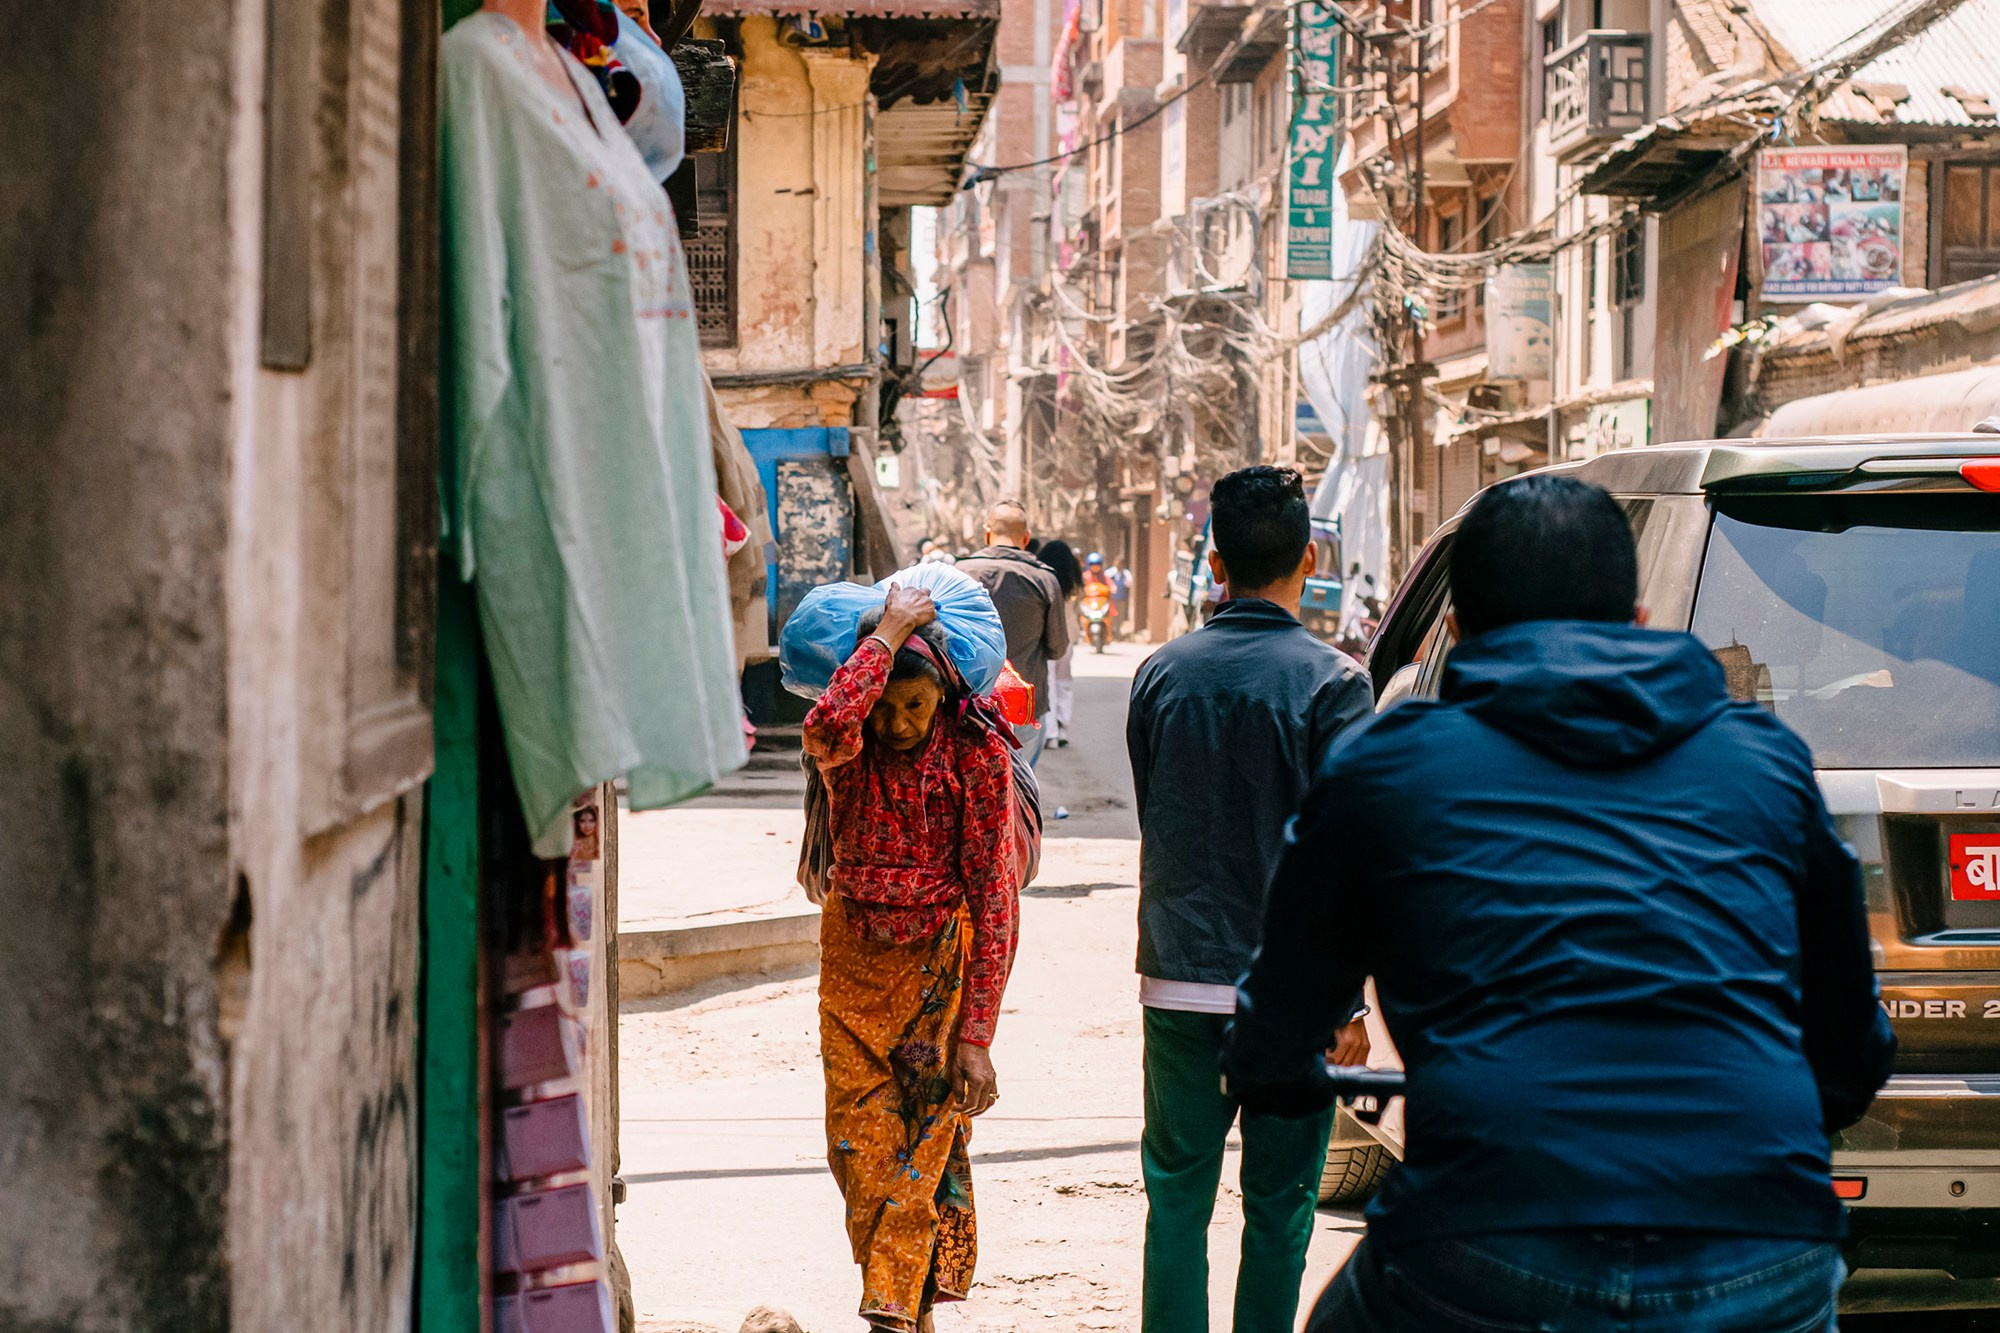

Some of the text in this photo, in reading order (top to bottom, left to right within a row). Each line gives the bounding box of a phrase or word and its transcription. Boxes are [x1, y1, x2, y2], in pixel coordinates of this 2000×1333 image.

[1787, 155, 1827, 167] NEWARI
[1830, 154, 1866, 167] KHAJA
[1293, 189, 1328, 205] TRADE
[1289, 227, 1330, 242] EXPORT
